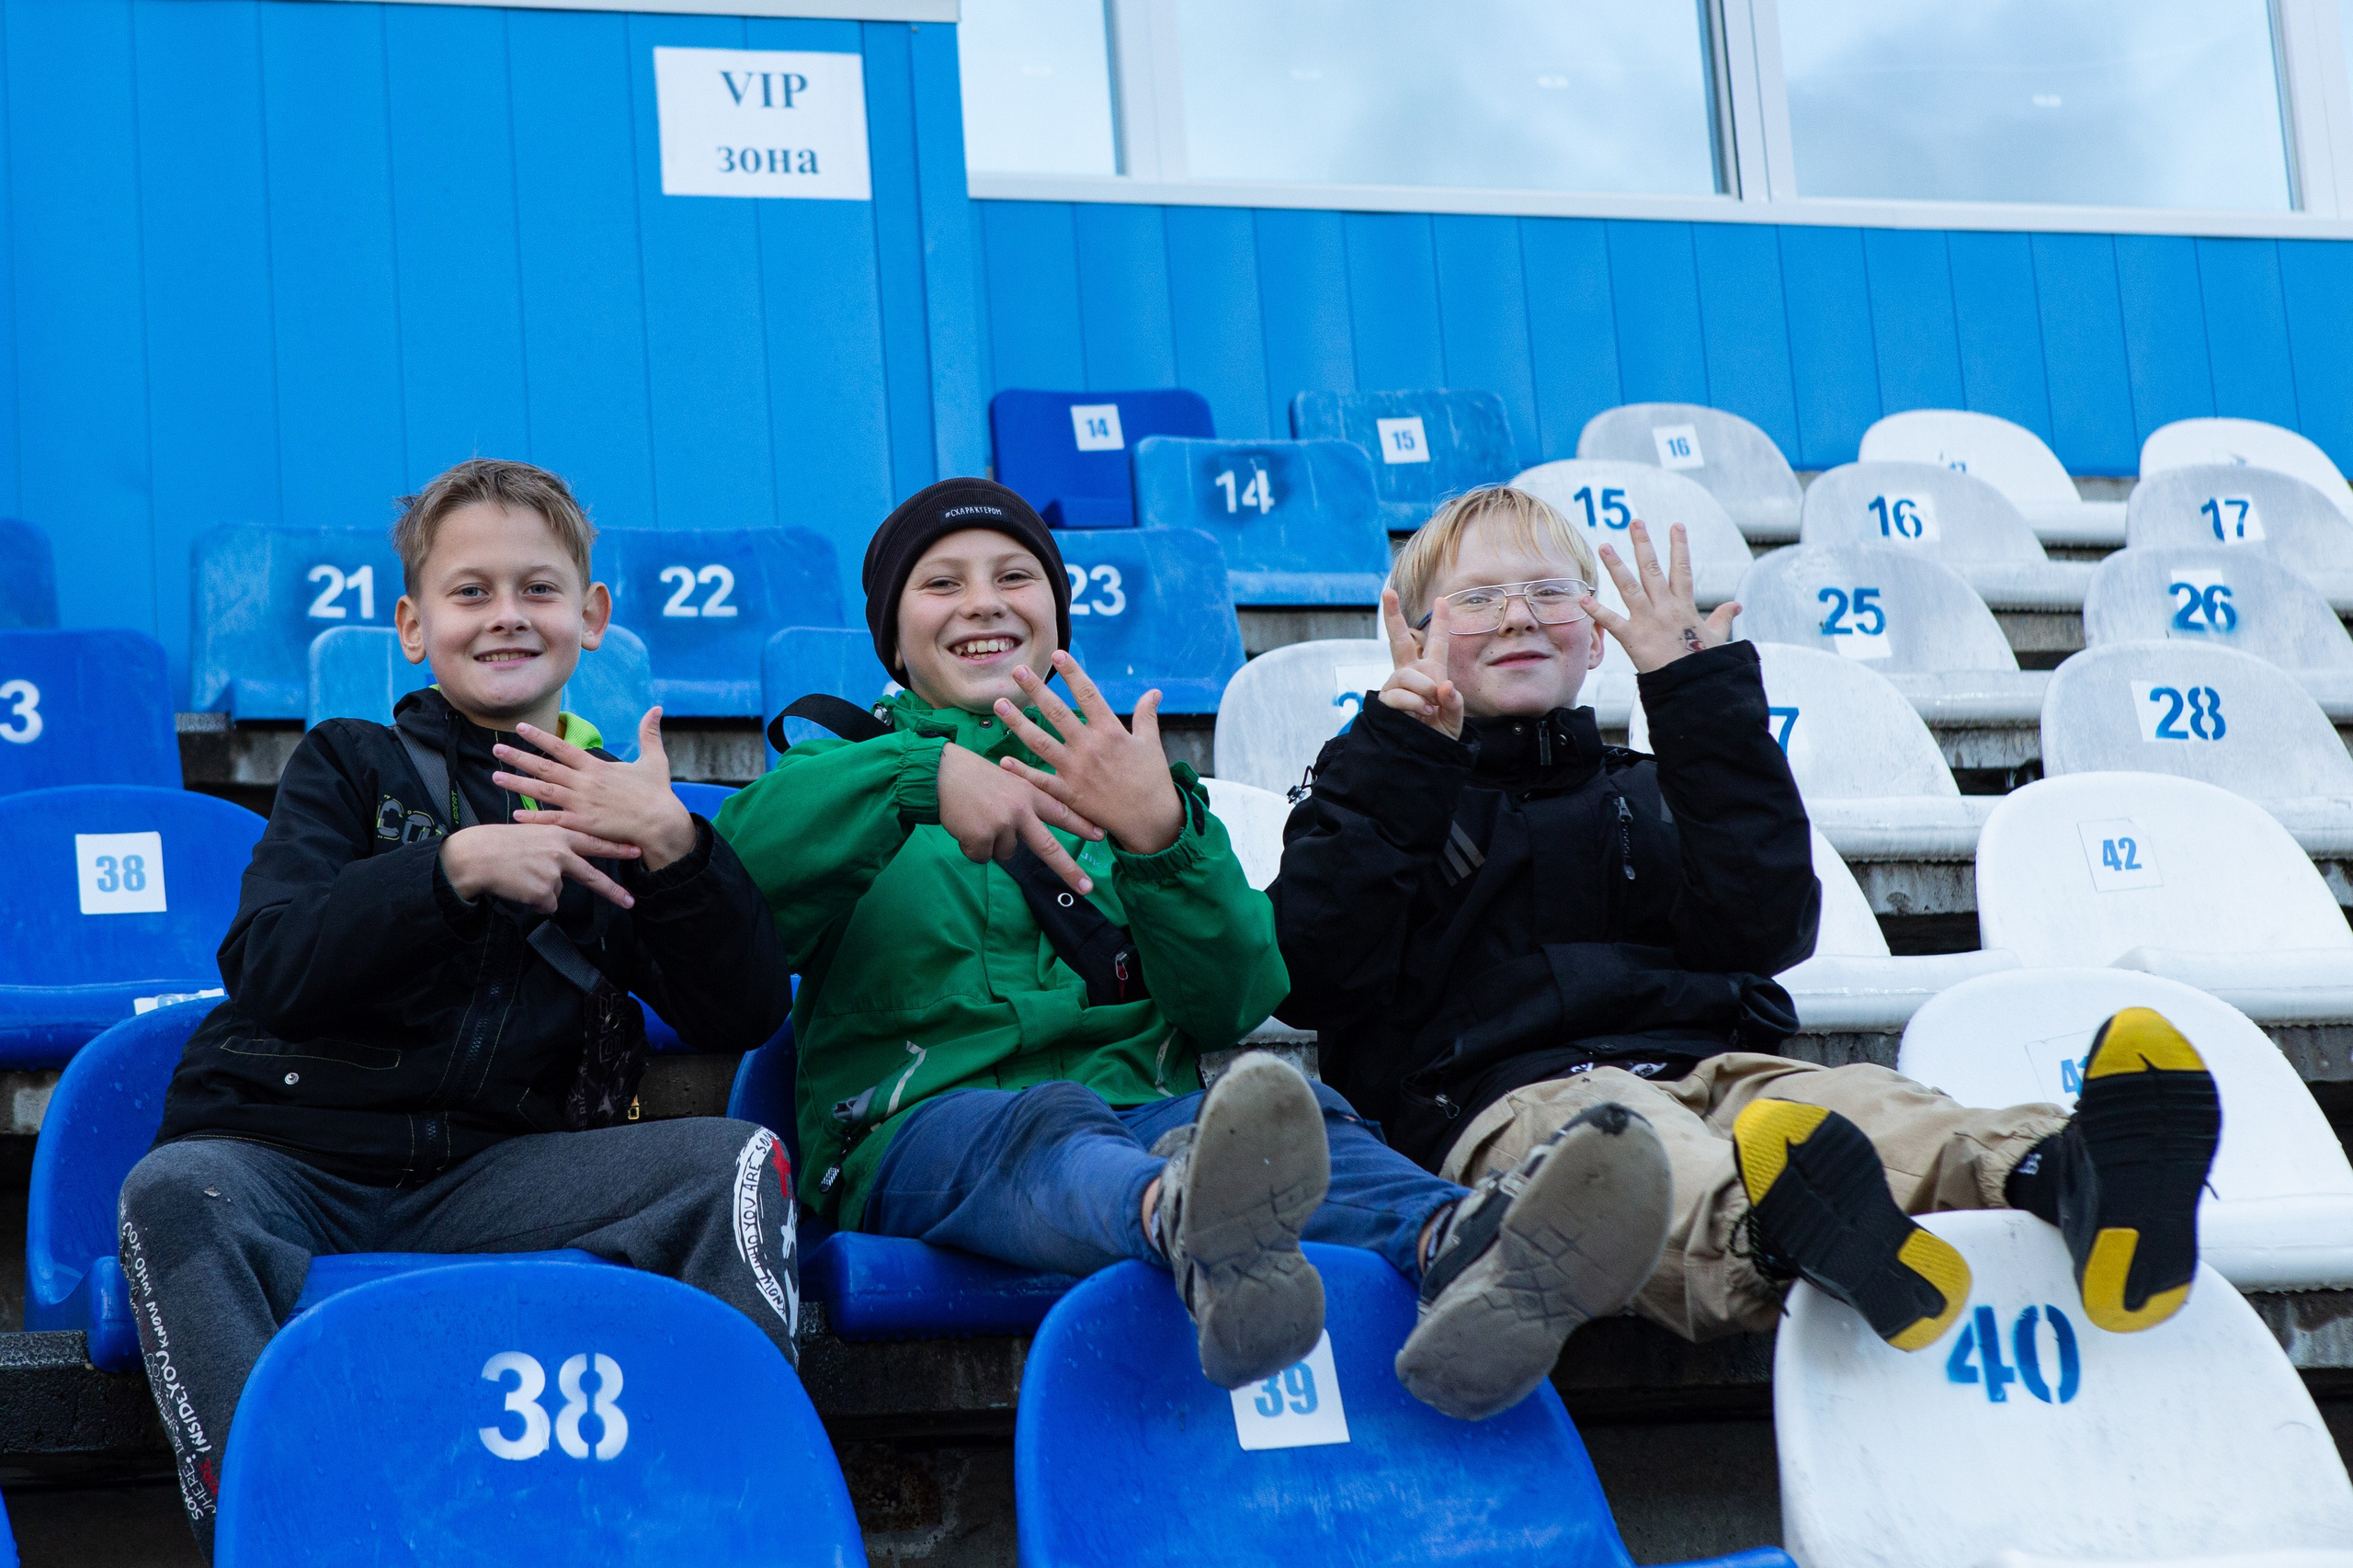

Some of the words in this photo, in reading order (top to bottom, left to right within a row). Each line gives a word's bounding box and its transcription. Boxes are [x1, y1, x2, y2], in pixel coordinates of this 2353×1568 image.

[719, 70, 809, 109] VIP
[717, 145, 820, 176] зона
[1087, 418, 1109, 437] 14
[1392, 431, 1415, 450] 15
[1667, 437, 1690, 457] 16
[1215, 469, 1276, 515] 14
[1574, 486, 1631, 530] 15
[1868, 495, 1923, 539] 16
[2200, 497, 2250, 542] 17
[308, 564, 375, 619] 21
[659, 564, 738, 618] 22
[1063, 562, 1127, 617] 23
[1818, 586, 1887, 636] 25
[2168, 582, 2237, 633] 26
[0, 678, 43, 744] 3
[1333, 691, 1368, 736] 2
[1768, 706, 1800, 760] 7
[2149, 686, 2228, 742] 28
[96, 854, 147, 892] 38
[2101, 836, 2143, 872] 42
[2061, 1055, 2088, 1099] 4
[755, 1131, 777, 1155] SOM
[743, 1161, 762, 1192] ARE
[744, 1197, 756, 1231] YOU
[122, 1221, 142, 1256] YOU
[134, 1257, 153, 1297] WHO
[145, 1301, 170, 1348] KNOW
[155, 1350, 181, 1399] YOU
[1945, 1302, 2081, 1404] 40
[478, 1351, 631, 1461] 38
[1253, 1360, 1320, 1418] 39
